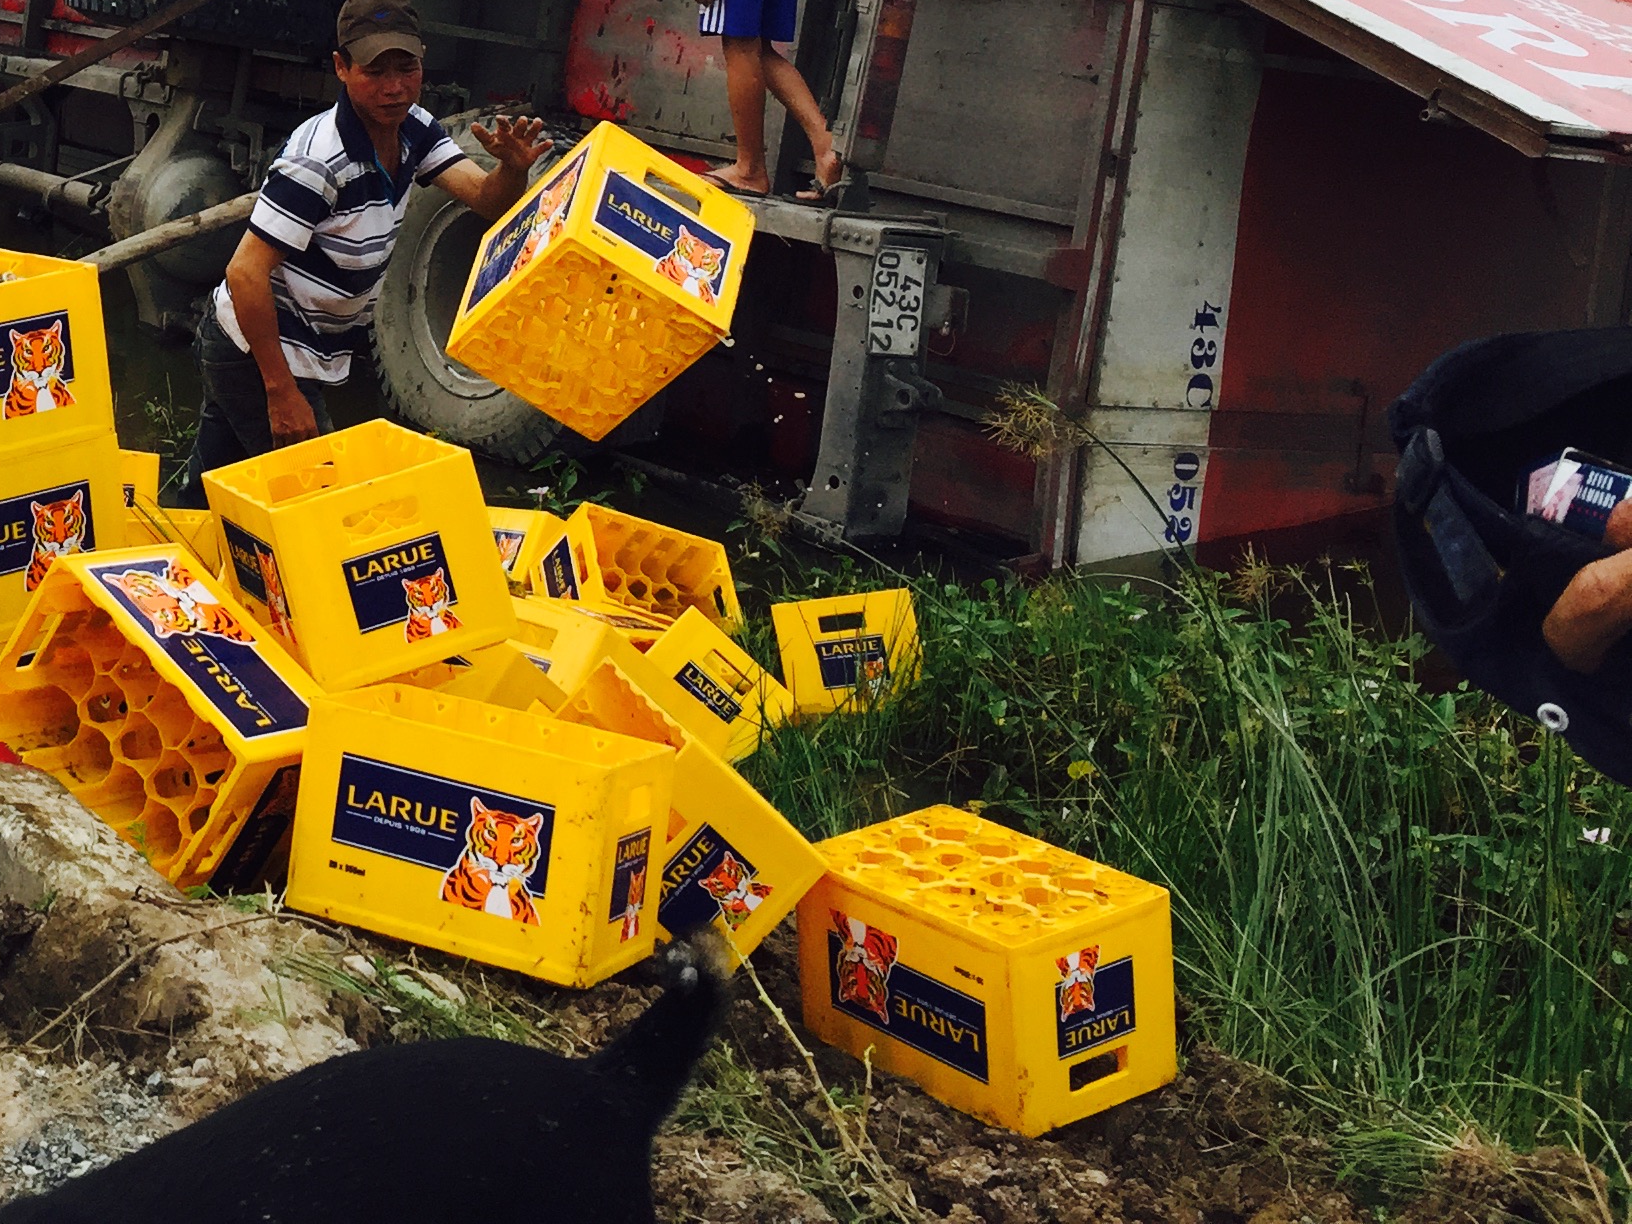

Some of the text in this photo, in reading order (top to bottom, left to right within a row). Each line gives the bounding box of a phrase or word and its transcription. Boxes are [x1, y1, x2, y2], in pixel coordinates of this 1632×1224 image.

[607, 192, 674, 241] LARUE
[869, 251, 901, 353] 052.12
[896, 274, 922, 332] 43C
[1186, 300, 1222, 408] 43C
[230, 541, 260, 574] LARUE
[350, 542, 435, 582] LARUE
[821, 640, 879, 656] LARUE
[181, 638, 272, 727] LARUE
[685, 668, 735, 715] LARUE
[347, 784, 460, 834] LARUE
[373, 816, 402, 829] DEPUIS
[618, 836, 648, 863] LARUE
[893, 994, 980, 1053] LARUE
[1065, 1009, 1130, 1048] LARUE
